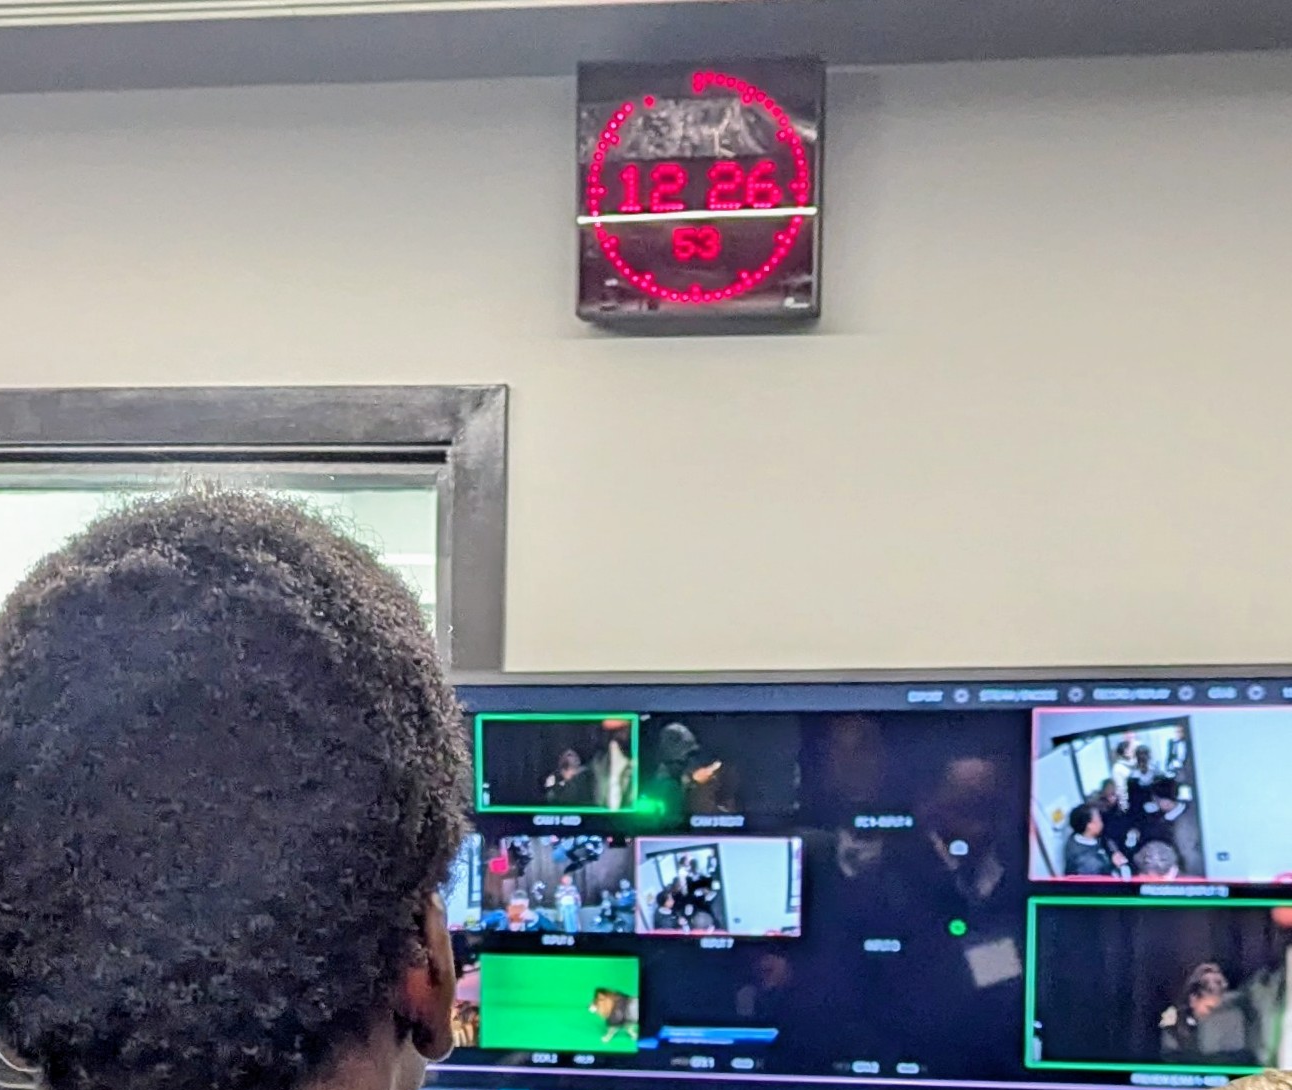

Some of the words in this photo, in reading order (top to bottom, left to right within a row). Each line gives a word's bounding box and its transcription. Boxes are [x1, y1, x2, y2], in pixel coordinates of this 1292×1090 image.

[619, 163, 688, 212] 12
[708, 161, 782, 209] 26
[672, 226, 721, 261] 53
